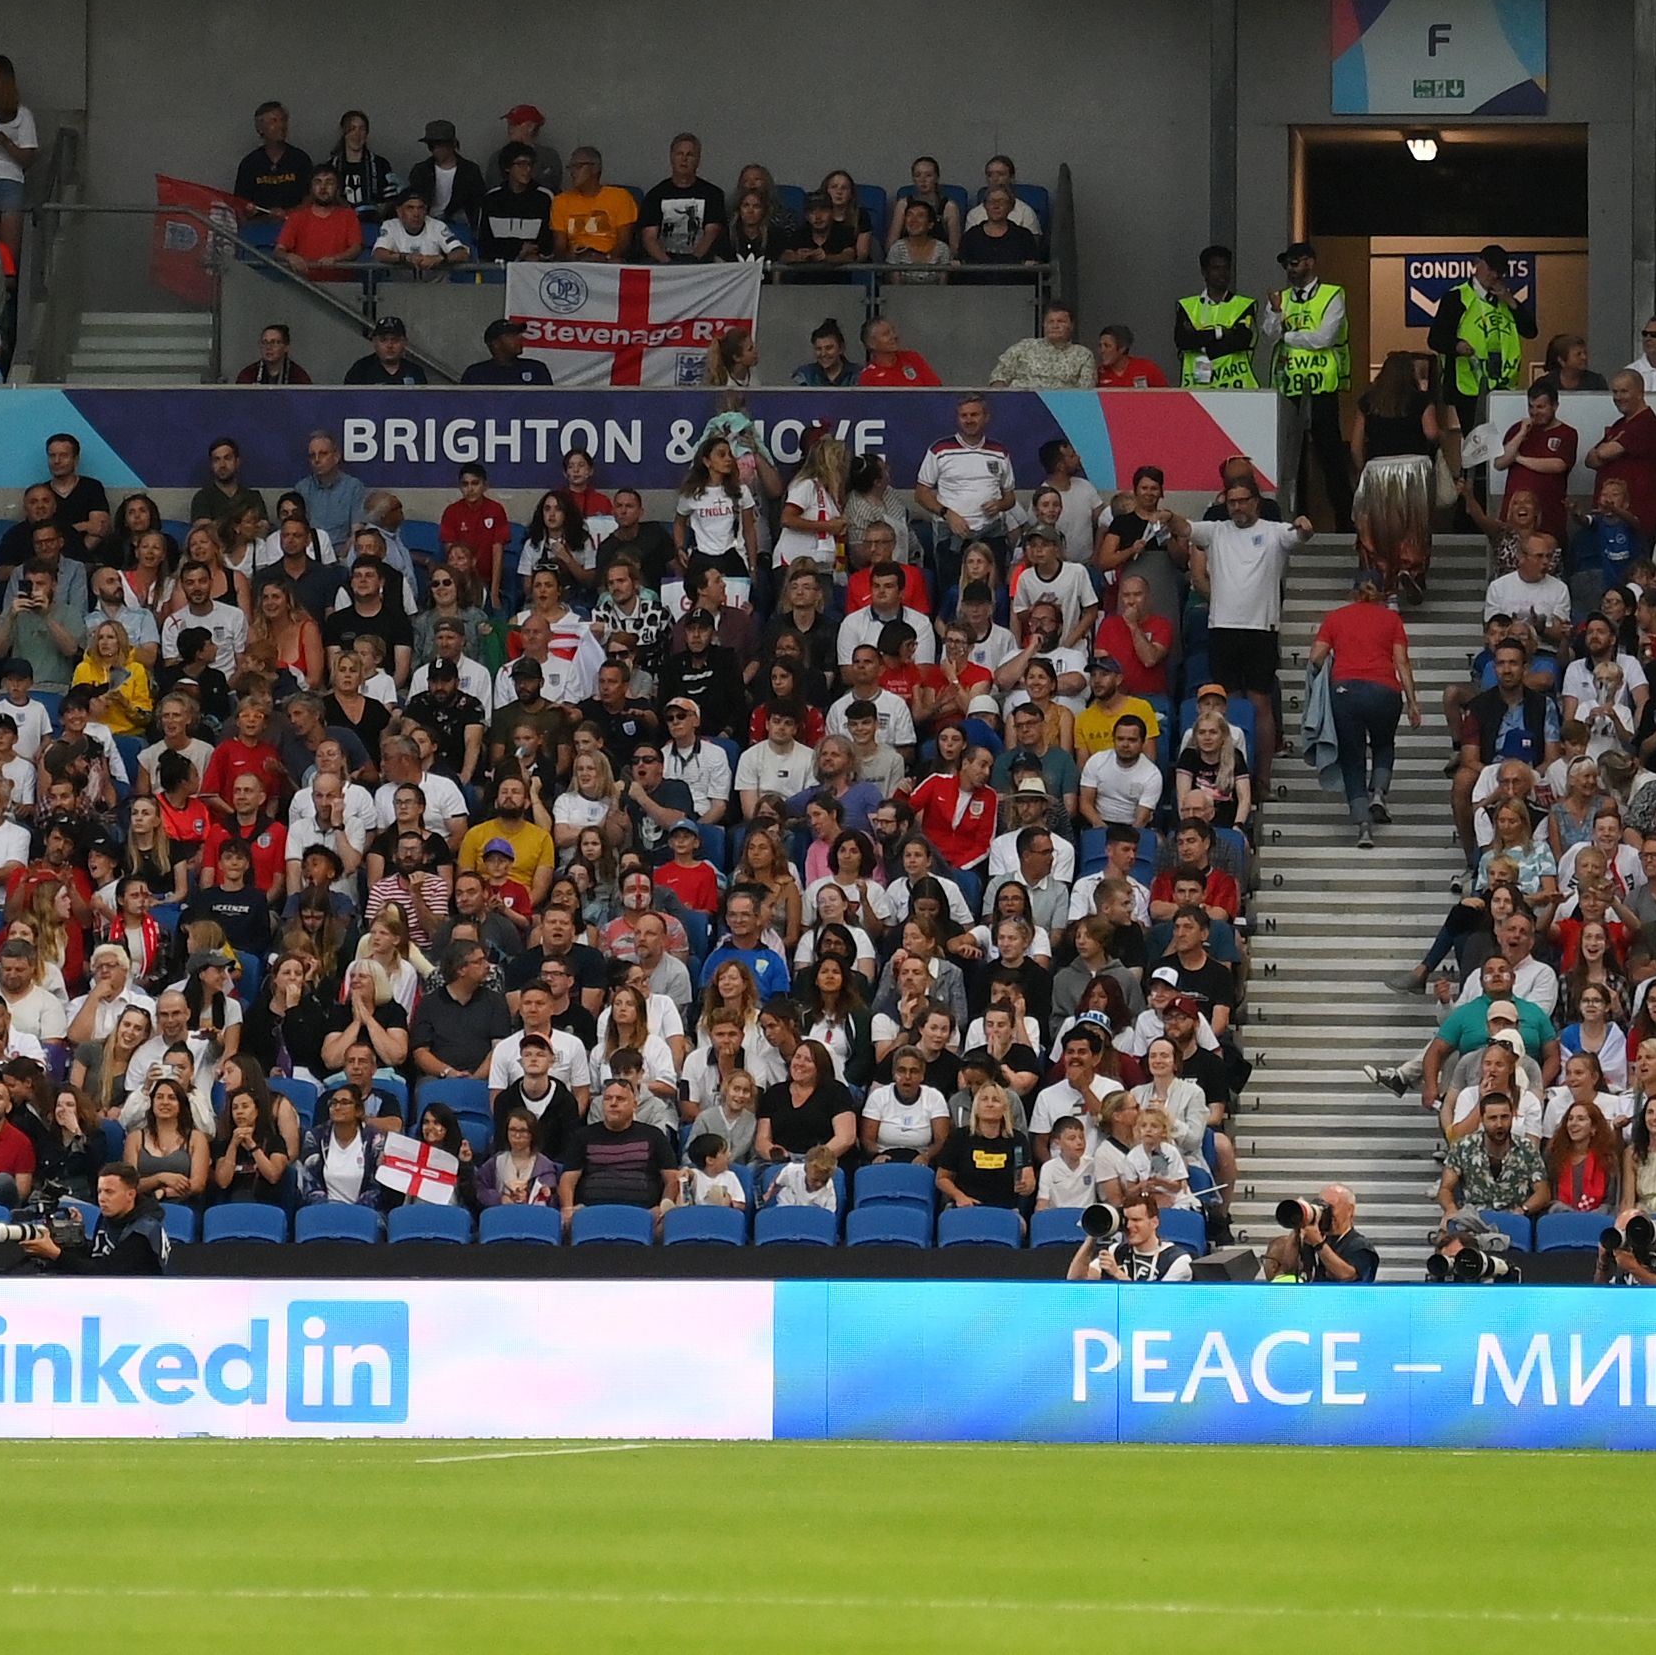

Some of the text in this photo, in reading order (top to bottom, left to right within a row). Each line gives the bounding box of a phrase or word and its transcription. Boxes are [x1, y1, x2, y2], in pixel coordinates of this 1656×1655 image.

[1427, 23, 1453, 57] F
[522, 320, 684, 347] Stevenage
[344, 418, 643, 464] BRIGHTON
[1265, 918, 1277, 932] N
[1264, 964, 1277, 977] M
[1257, 1008, 1267, 1021] L
[1255, 1053, 1267, 1066] K
[1244, 1186, 1255, 1200] H
[1073, 1328, 1367, 1406] PEACE
